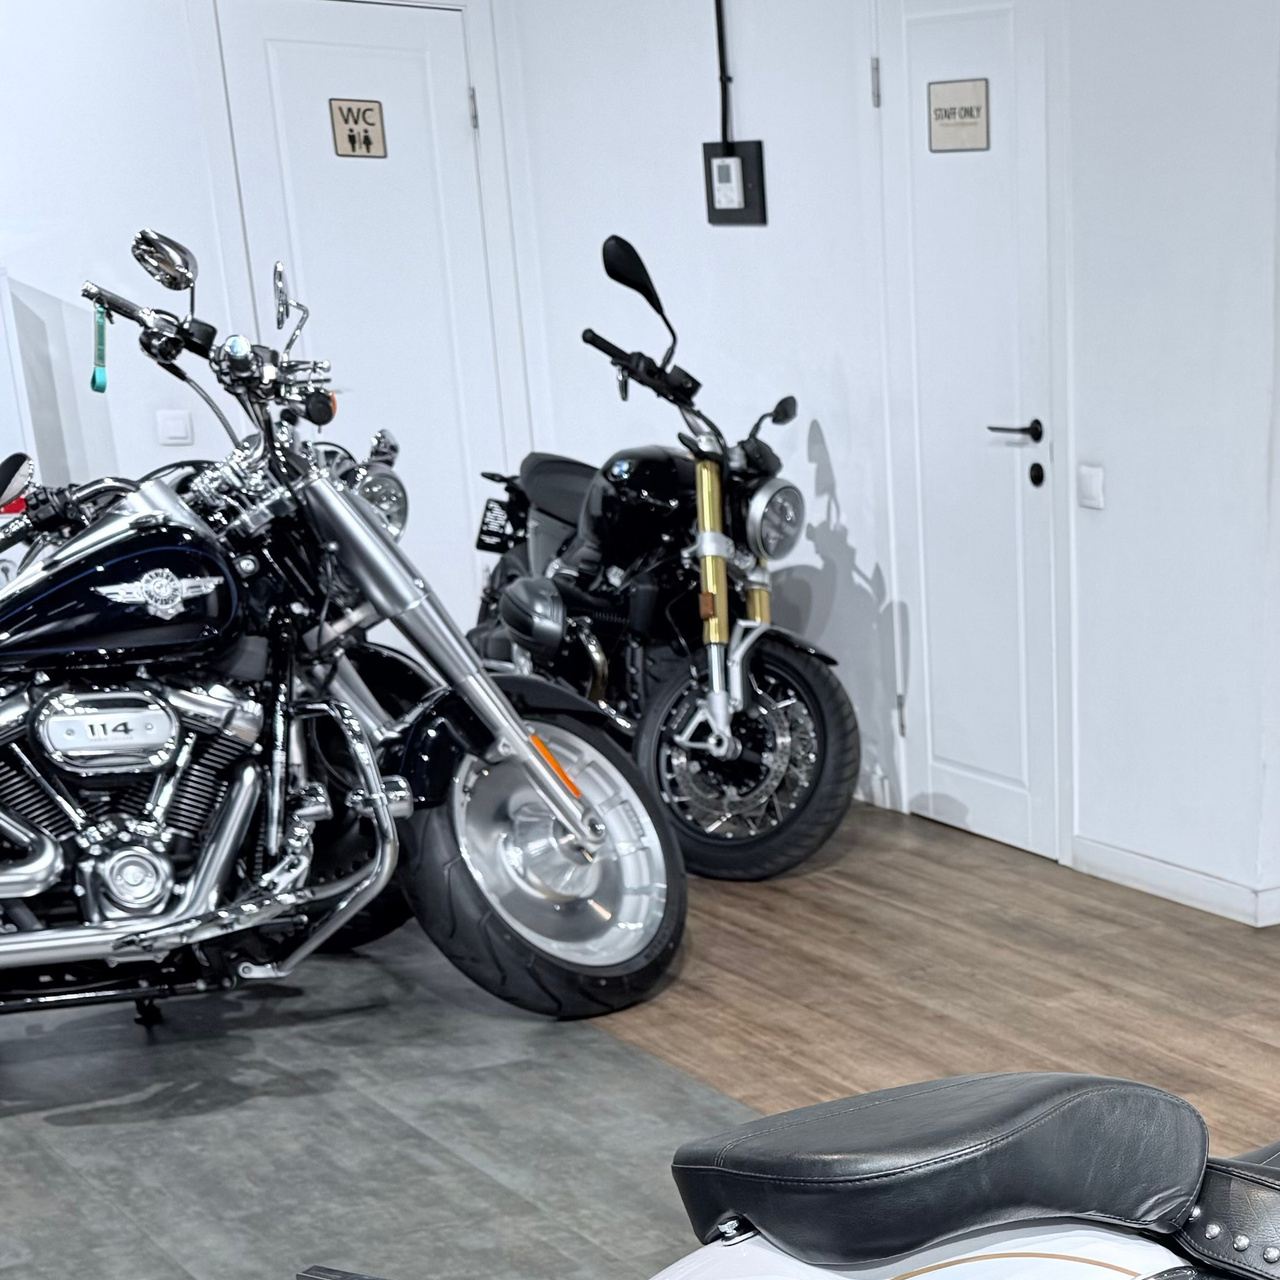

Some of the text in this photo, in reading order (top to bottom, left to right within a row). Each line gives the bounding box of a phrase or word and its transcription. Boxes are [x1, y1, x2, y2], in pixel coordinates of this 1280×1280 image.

[338, 106, 376, 127] WC
[958, 104, 982, 120] ONLY
[88, 721, 134, 737] 114
